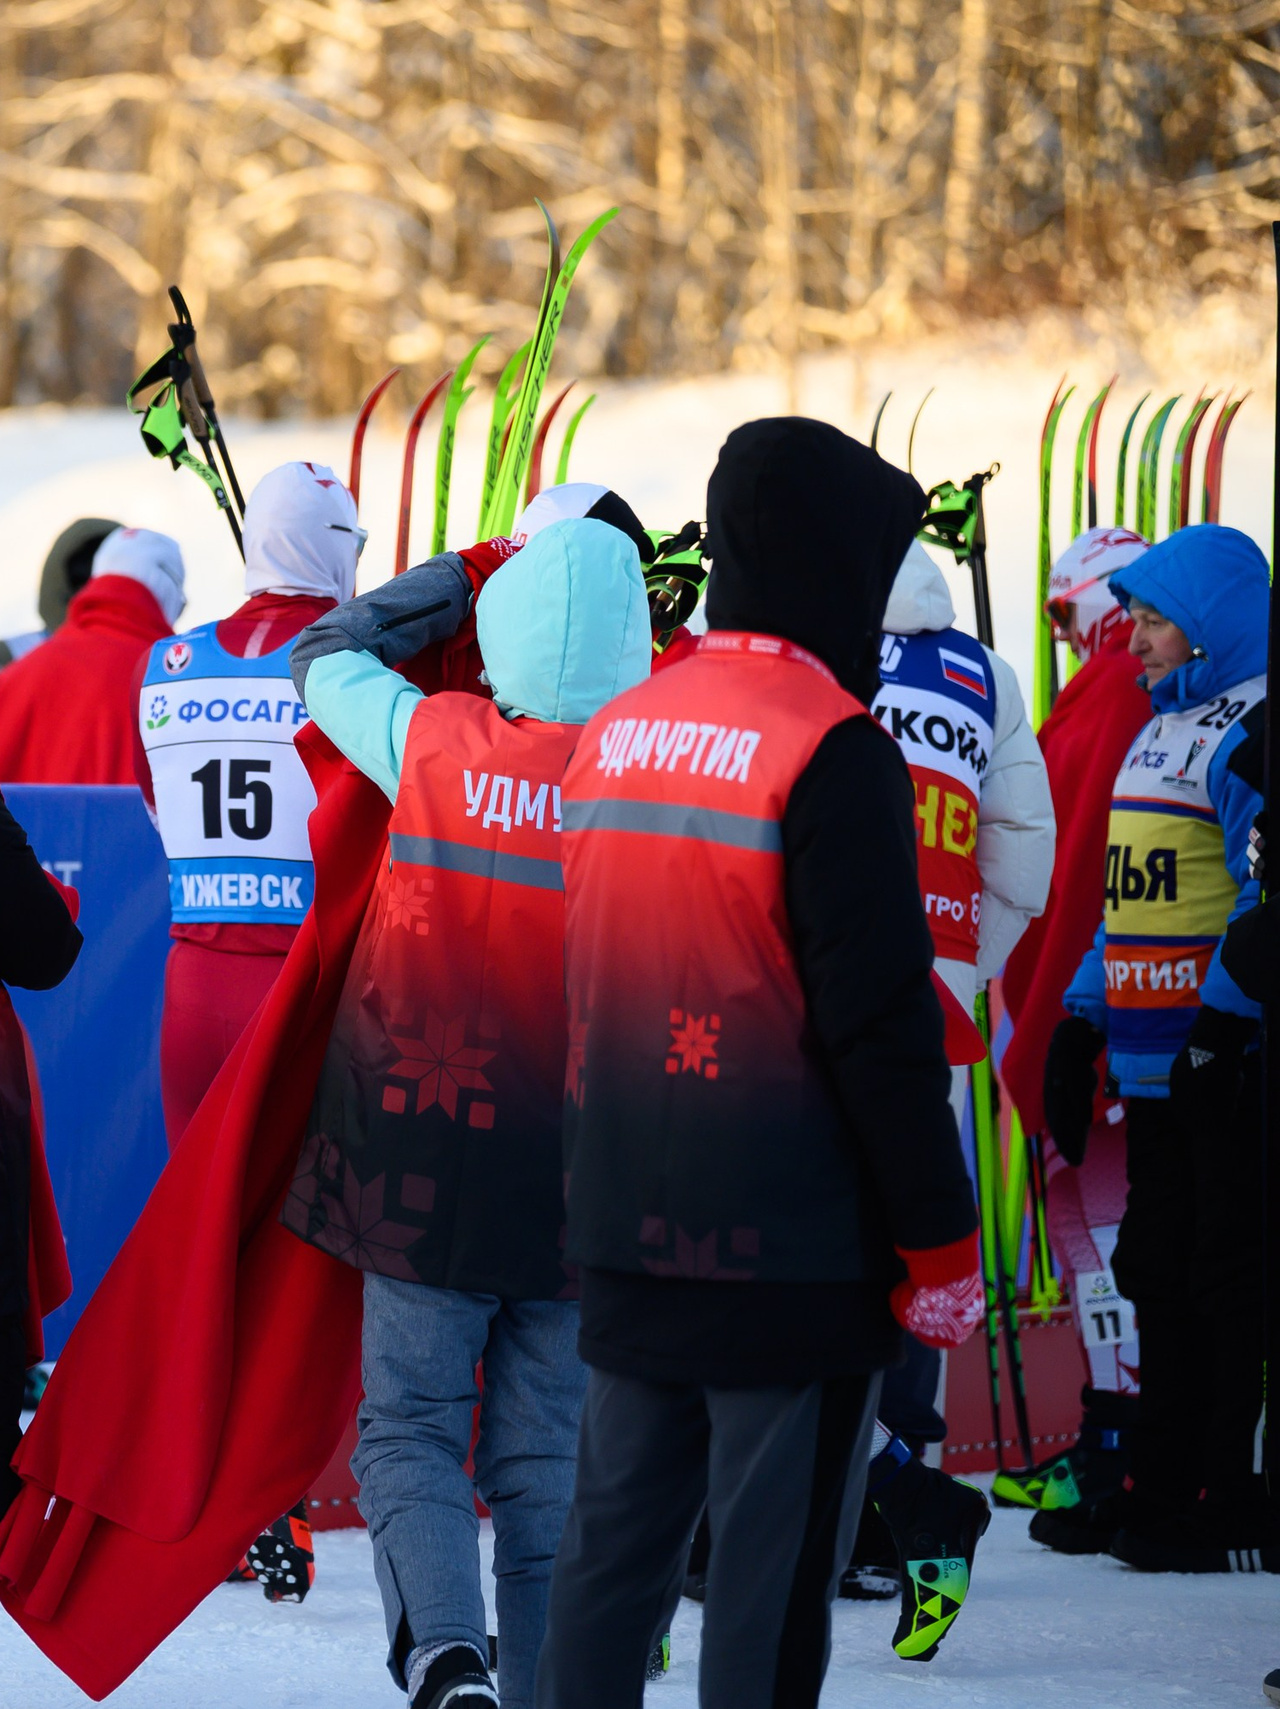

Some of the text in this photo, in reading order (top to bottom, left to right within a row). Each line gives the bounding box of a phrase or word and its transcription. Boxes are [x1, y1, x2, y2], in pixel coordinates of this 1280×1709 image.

[513, 300, 560, 489] FISCHER
[1196, 696, 1247, 731] 29
[596, 717, 762, 784] УДМУРТИЯ
[191, 759, 273, 841] 15
[181, 873, 304, 909] ИЖЕВСК
[1090, 1309, 1122, 1342] 11
